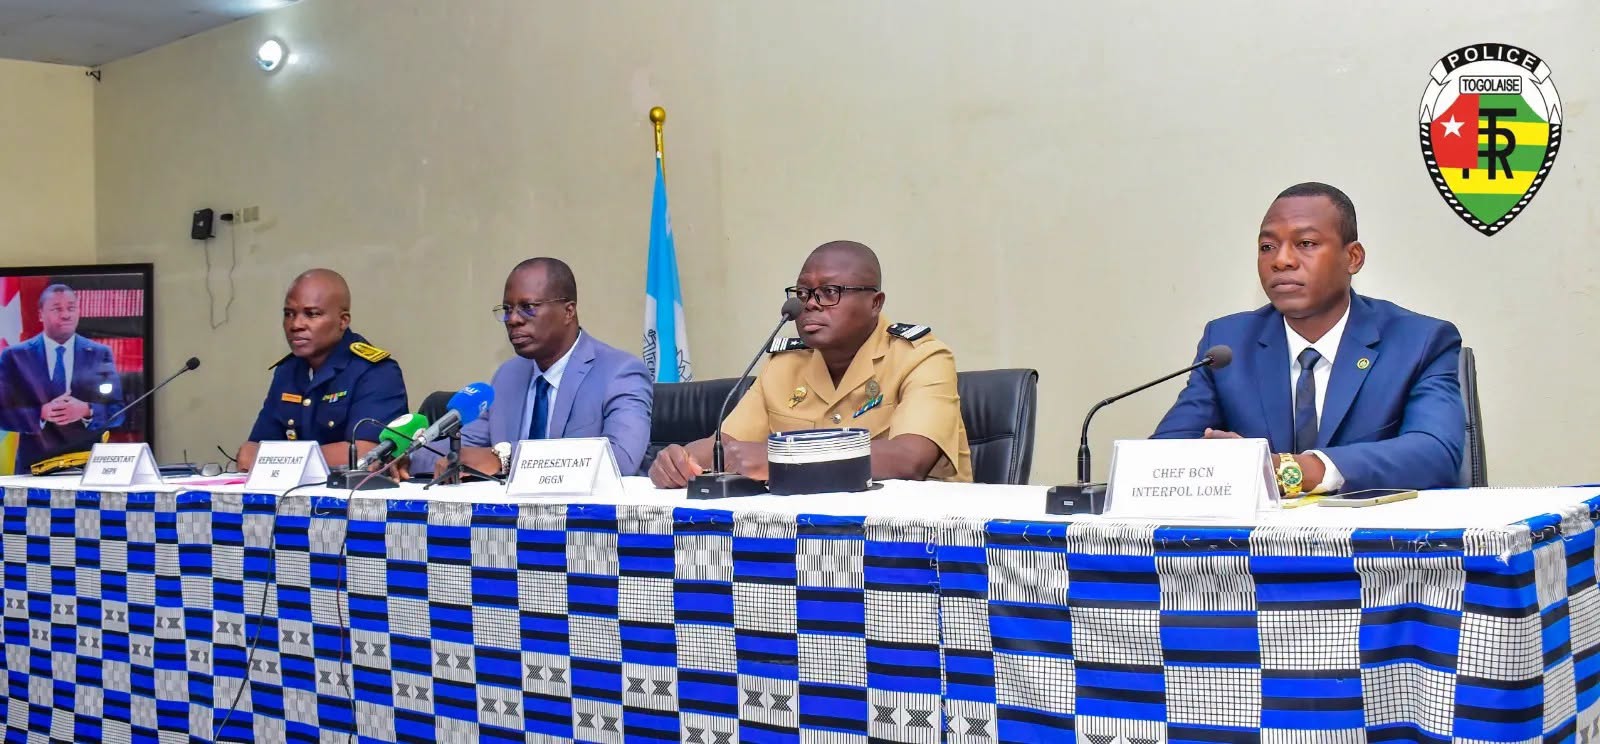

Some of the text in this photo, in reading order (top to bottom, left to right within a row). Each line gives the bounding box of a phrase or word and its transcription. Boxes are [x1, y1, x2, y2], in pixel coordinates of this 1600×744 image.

[92, 455, 136, 463] REPRESENTANT
[257, 455, 304, 465] REPRESENTANT
[520, 457, 593, 470] REPRESENTANT
[1152, 466, 1214, 479] CHEF BCN
[538, 474, 565, 485] DGGN
[1131, 486, 1193, 498] INTERPOL
